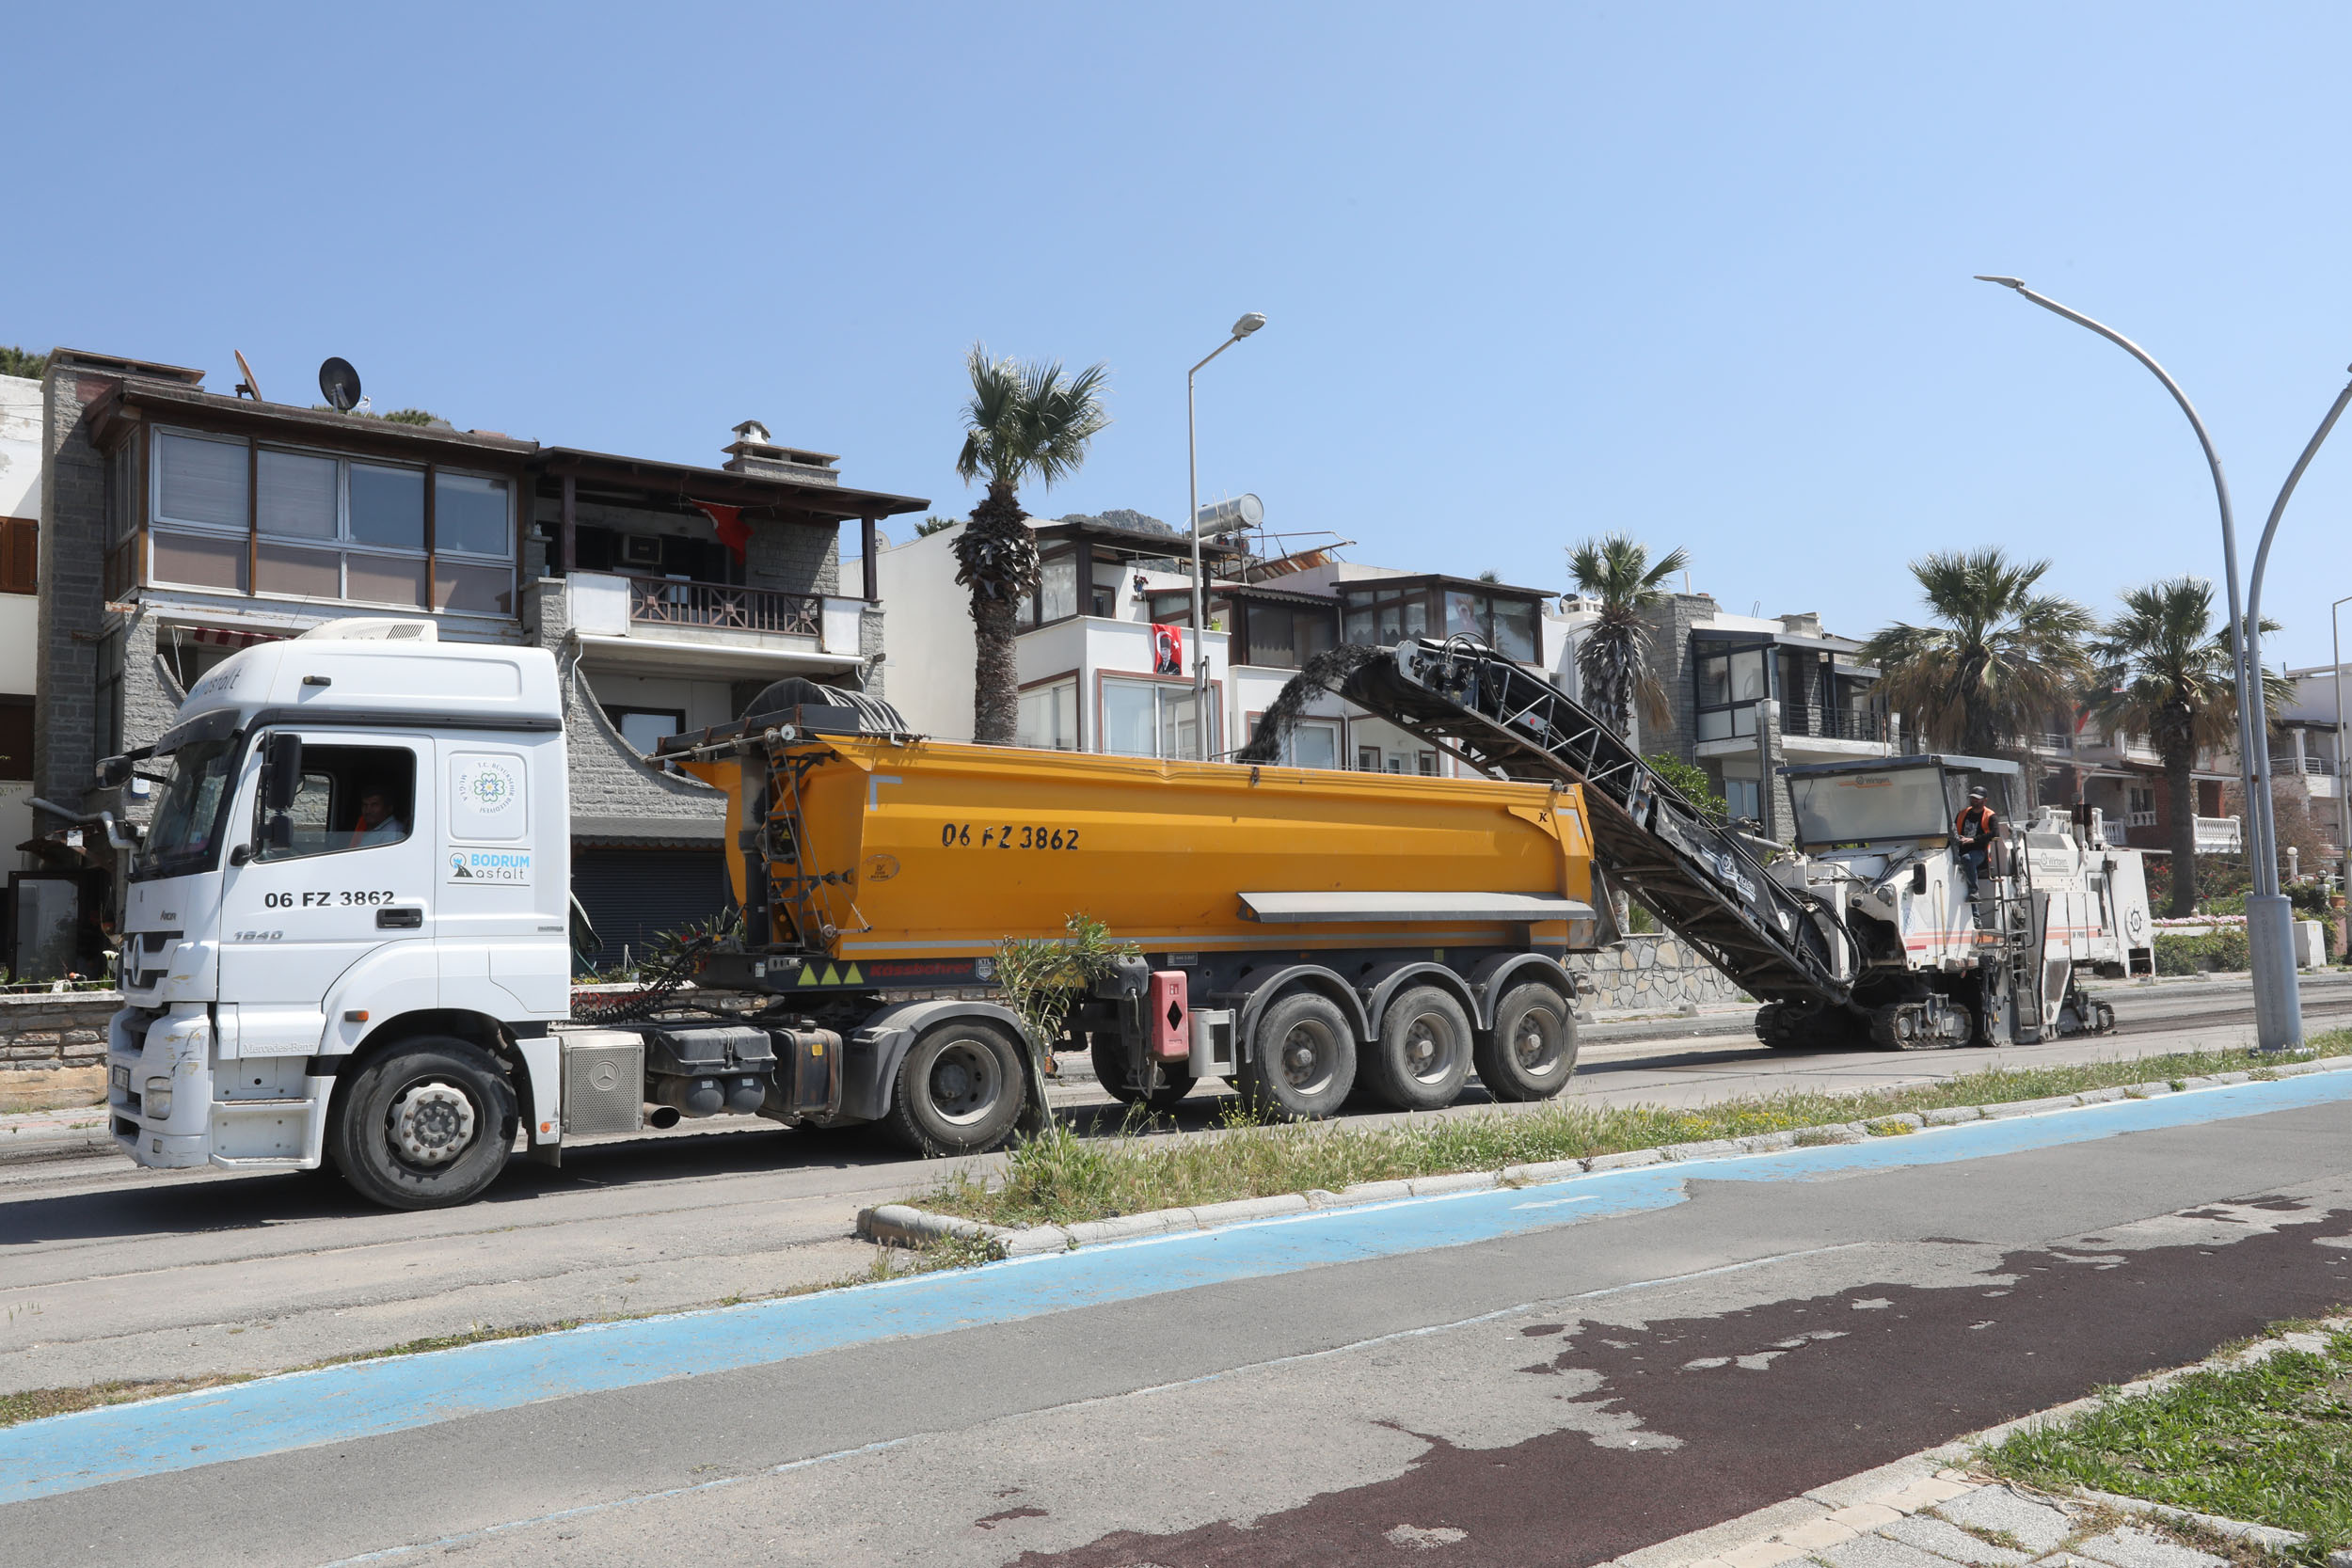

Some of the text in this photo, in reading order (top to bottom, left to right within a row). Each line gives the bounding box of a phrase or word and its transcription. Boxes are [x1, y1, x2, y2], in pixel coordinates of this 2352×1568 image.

[942, 823, 1079, 850] 06 FZ 3862
[471, 854, 530, 867] BODRUM
[475, 867, 524, 879] asfalt
[264, 891, 395, 908] 06 FZ 3862
